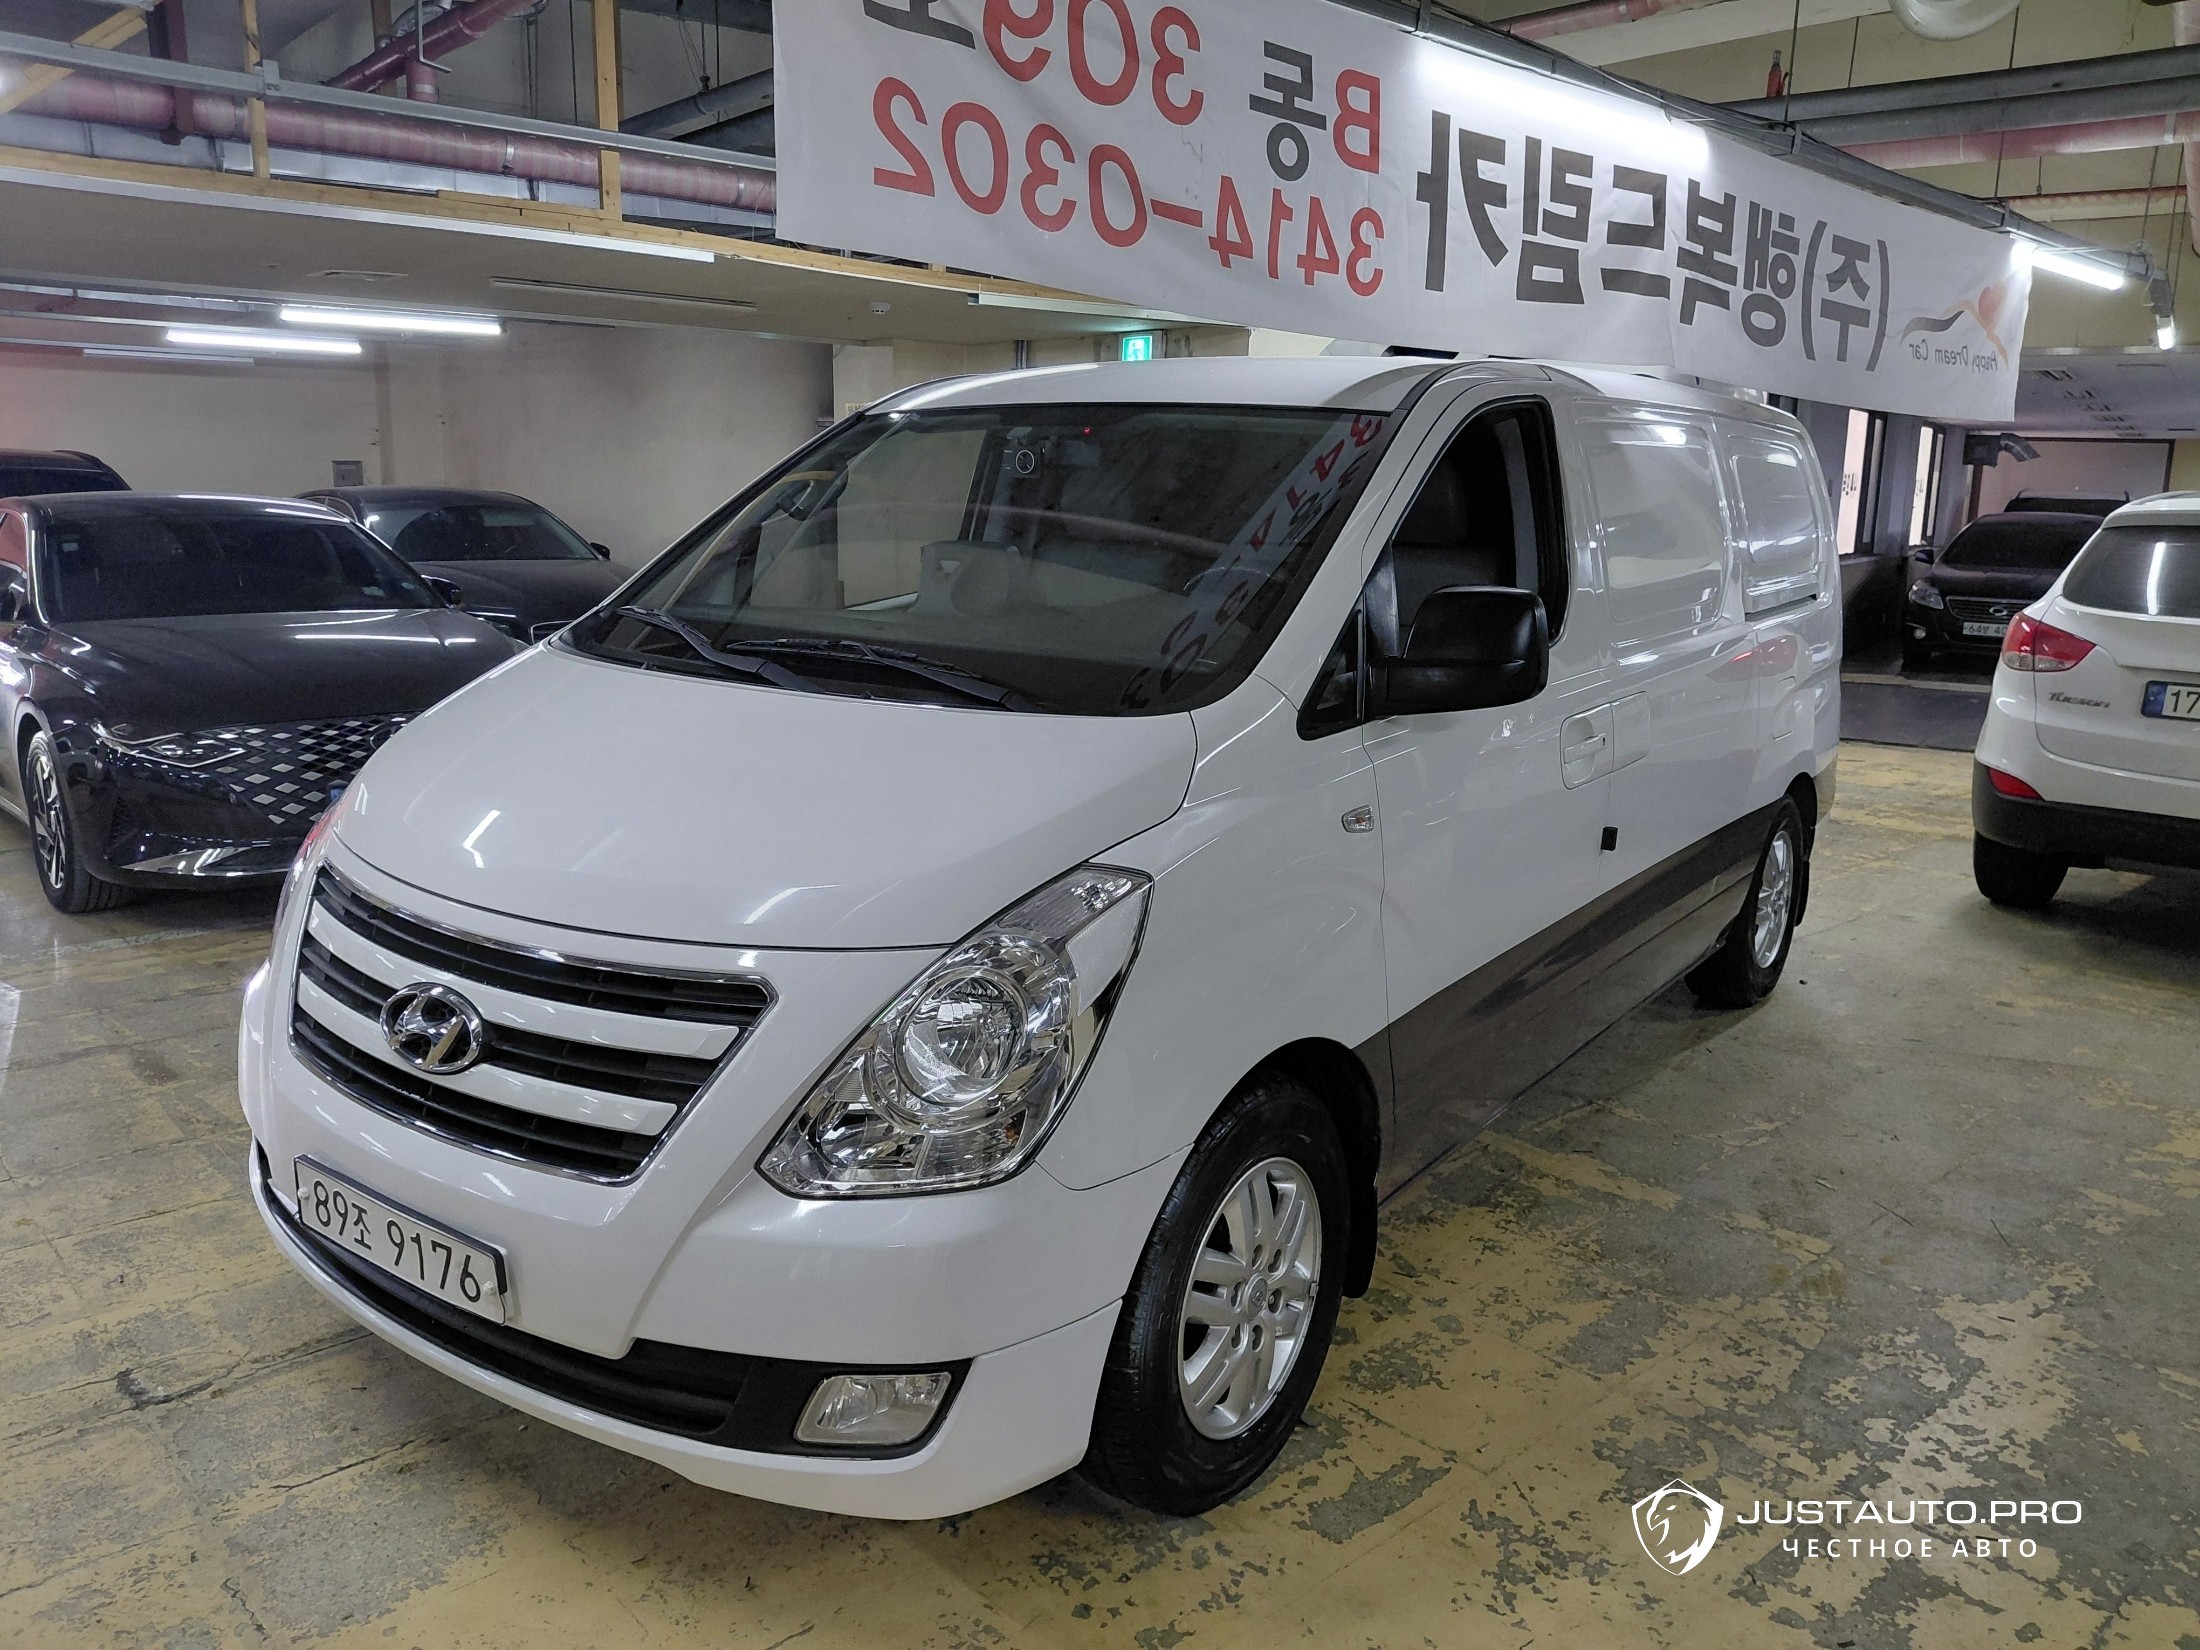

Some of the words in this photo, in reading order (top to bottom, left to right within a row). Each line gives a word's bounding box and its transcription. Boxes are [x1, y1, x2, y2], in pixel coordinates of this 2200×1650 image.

[2170, 690, 2200, 714] 17
[313, 1179, 372, 1251] 89조
[386, 1218, 481, 1303] 9176
